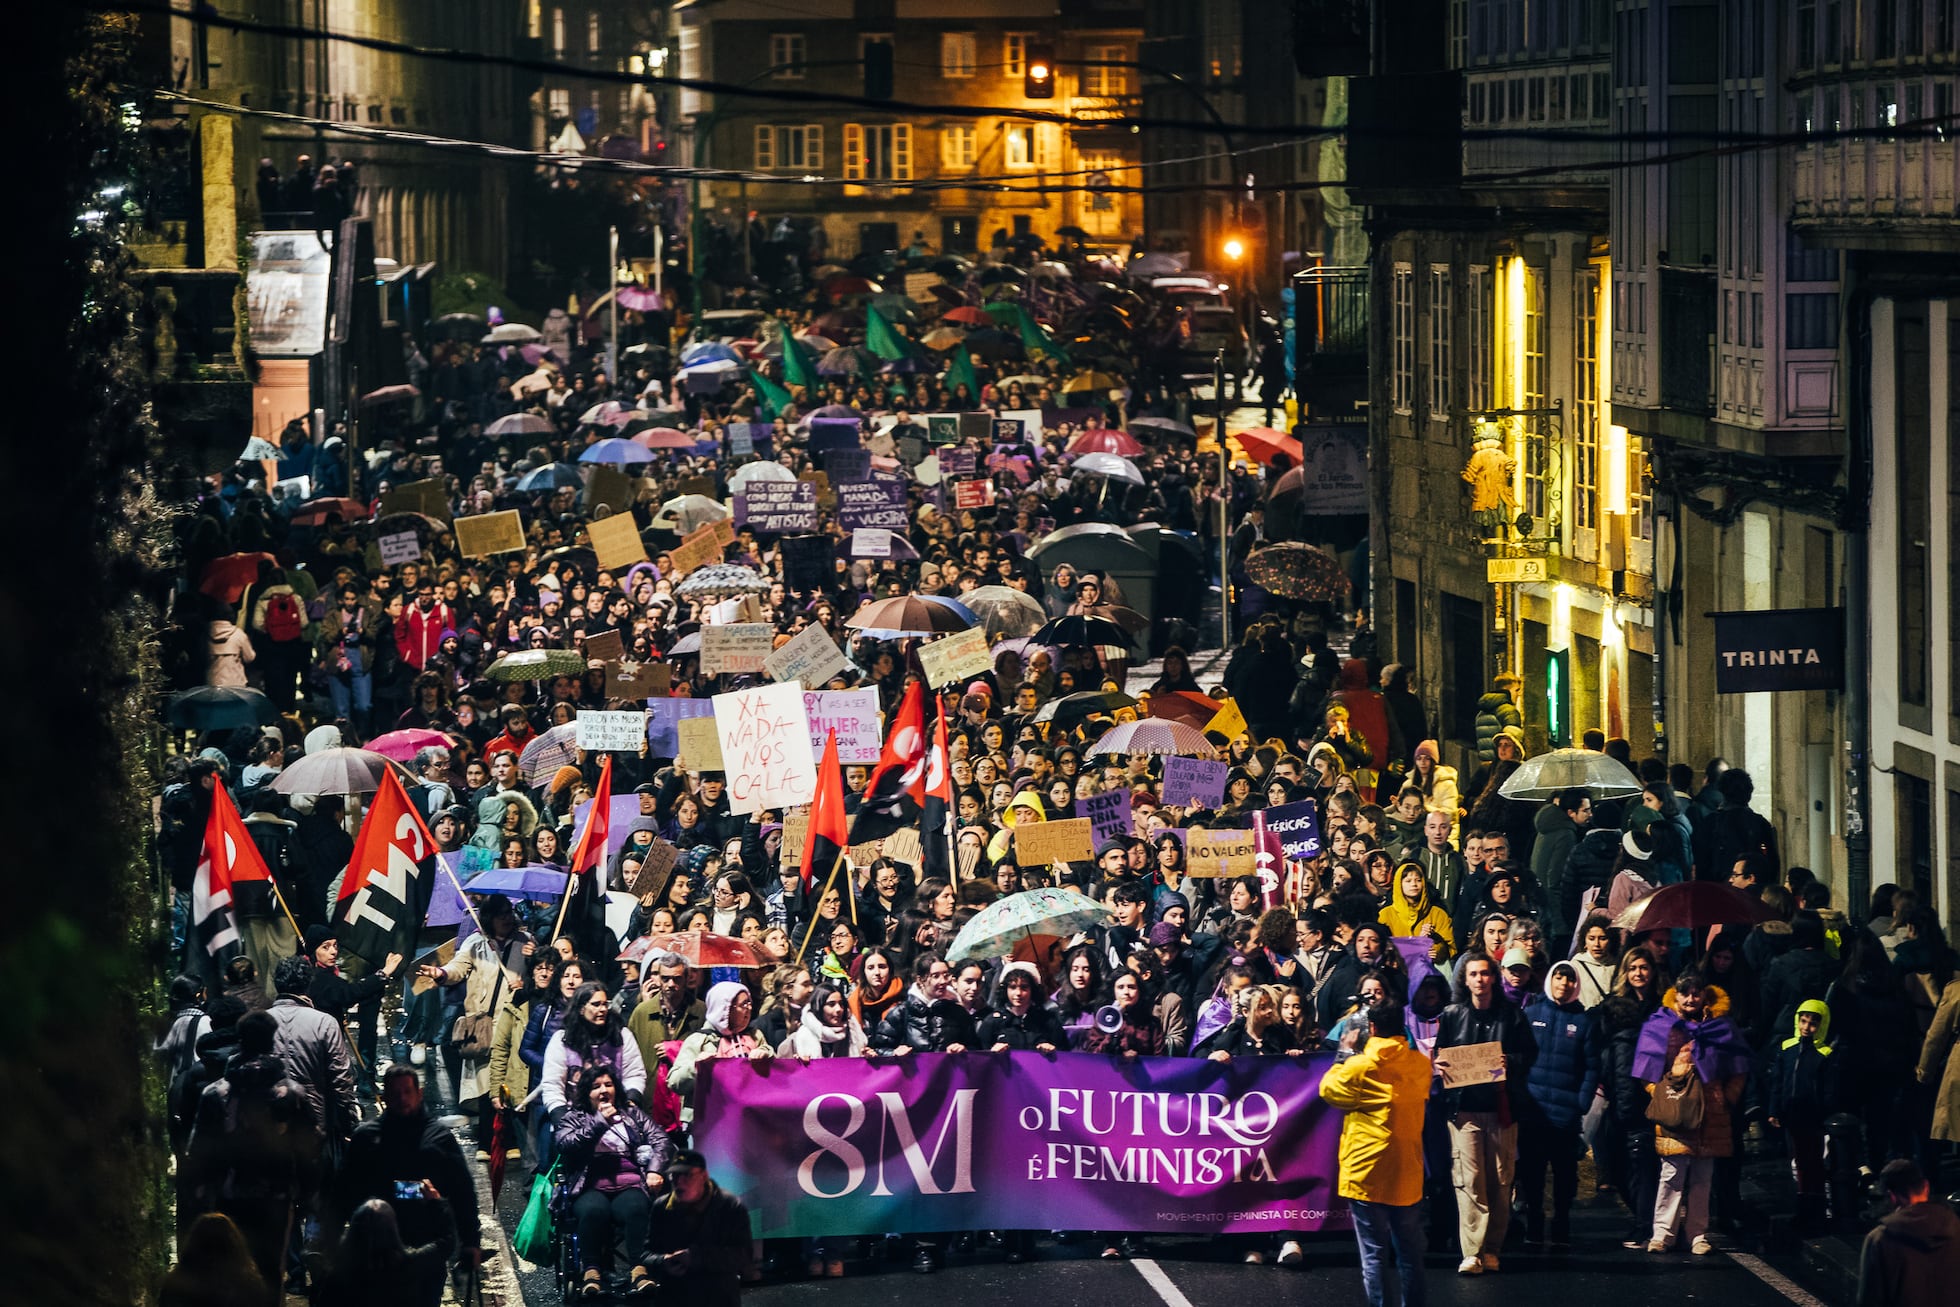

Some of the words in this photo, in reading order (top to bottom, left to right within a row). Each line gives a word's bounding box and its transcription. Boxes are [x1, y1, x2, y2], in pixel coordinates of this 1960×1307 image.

[839, 483, 880, 493] NUESTRA
[844, 491, 890, 502] MANADA
[765, 513, 811, 529] ARTISTAS
[858, 510, 909, 525] VUESTRA
[947, 639, 988, 661] LIBRES
[1722, 648, 1820, 668] TRINTA
[780, 656, 810, 682] LIBRE
[737, 695, 772, 721] XA
[727, 716, 796, 750] NADA
[809, 717, 860, 734] MUJER
[743, 741, 786, 770] NOS
[855, 748, 877, 759] SER
[733, 767, 806, 800] CALA
[1086, 793, 1122, 813] SEXO
[1097, 821, 1127, 839] TUS
[1018, 841, 1039, 853] NO
[1191, 846, 1210, 858] NO
[1048, 1087, 1280, 1146] FUTURO
[797, 1088, 980, 1199] 8M
[1046, 1142, 1279, 1185] FEMINISTA
[1156, 1212, 1225, 1222] MOVEMENTO
[1227, 1210, 1281, 1220] FEMINISTA
[1283, 1210, 1299, 1220] DE
